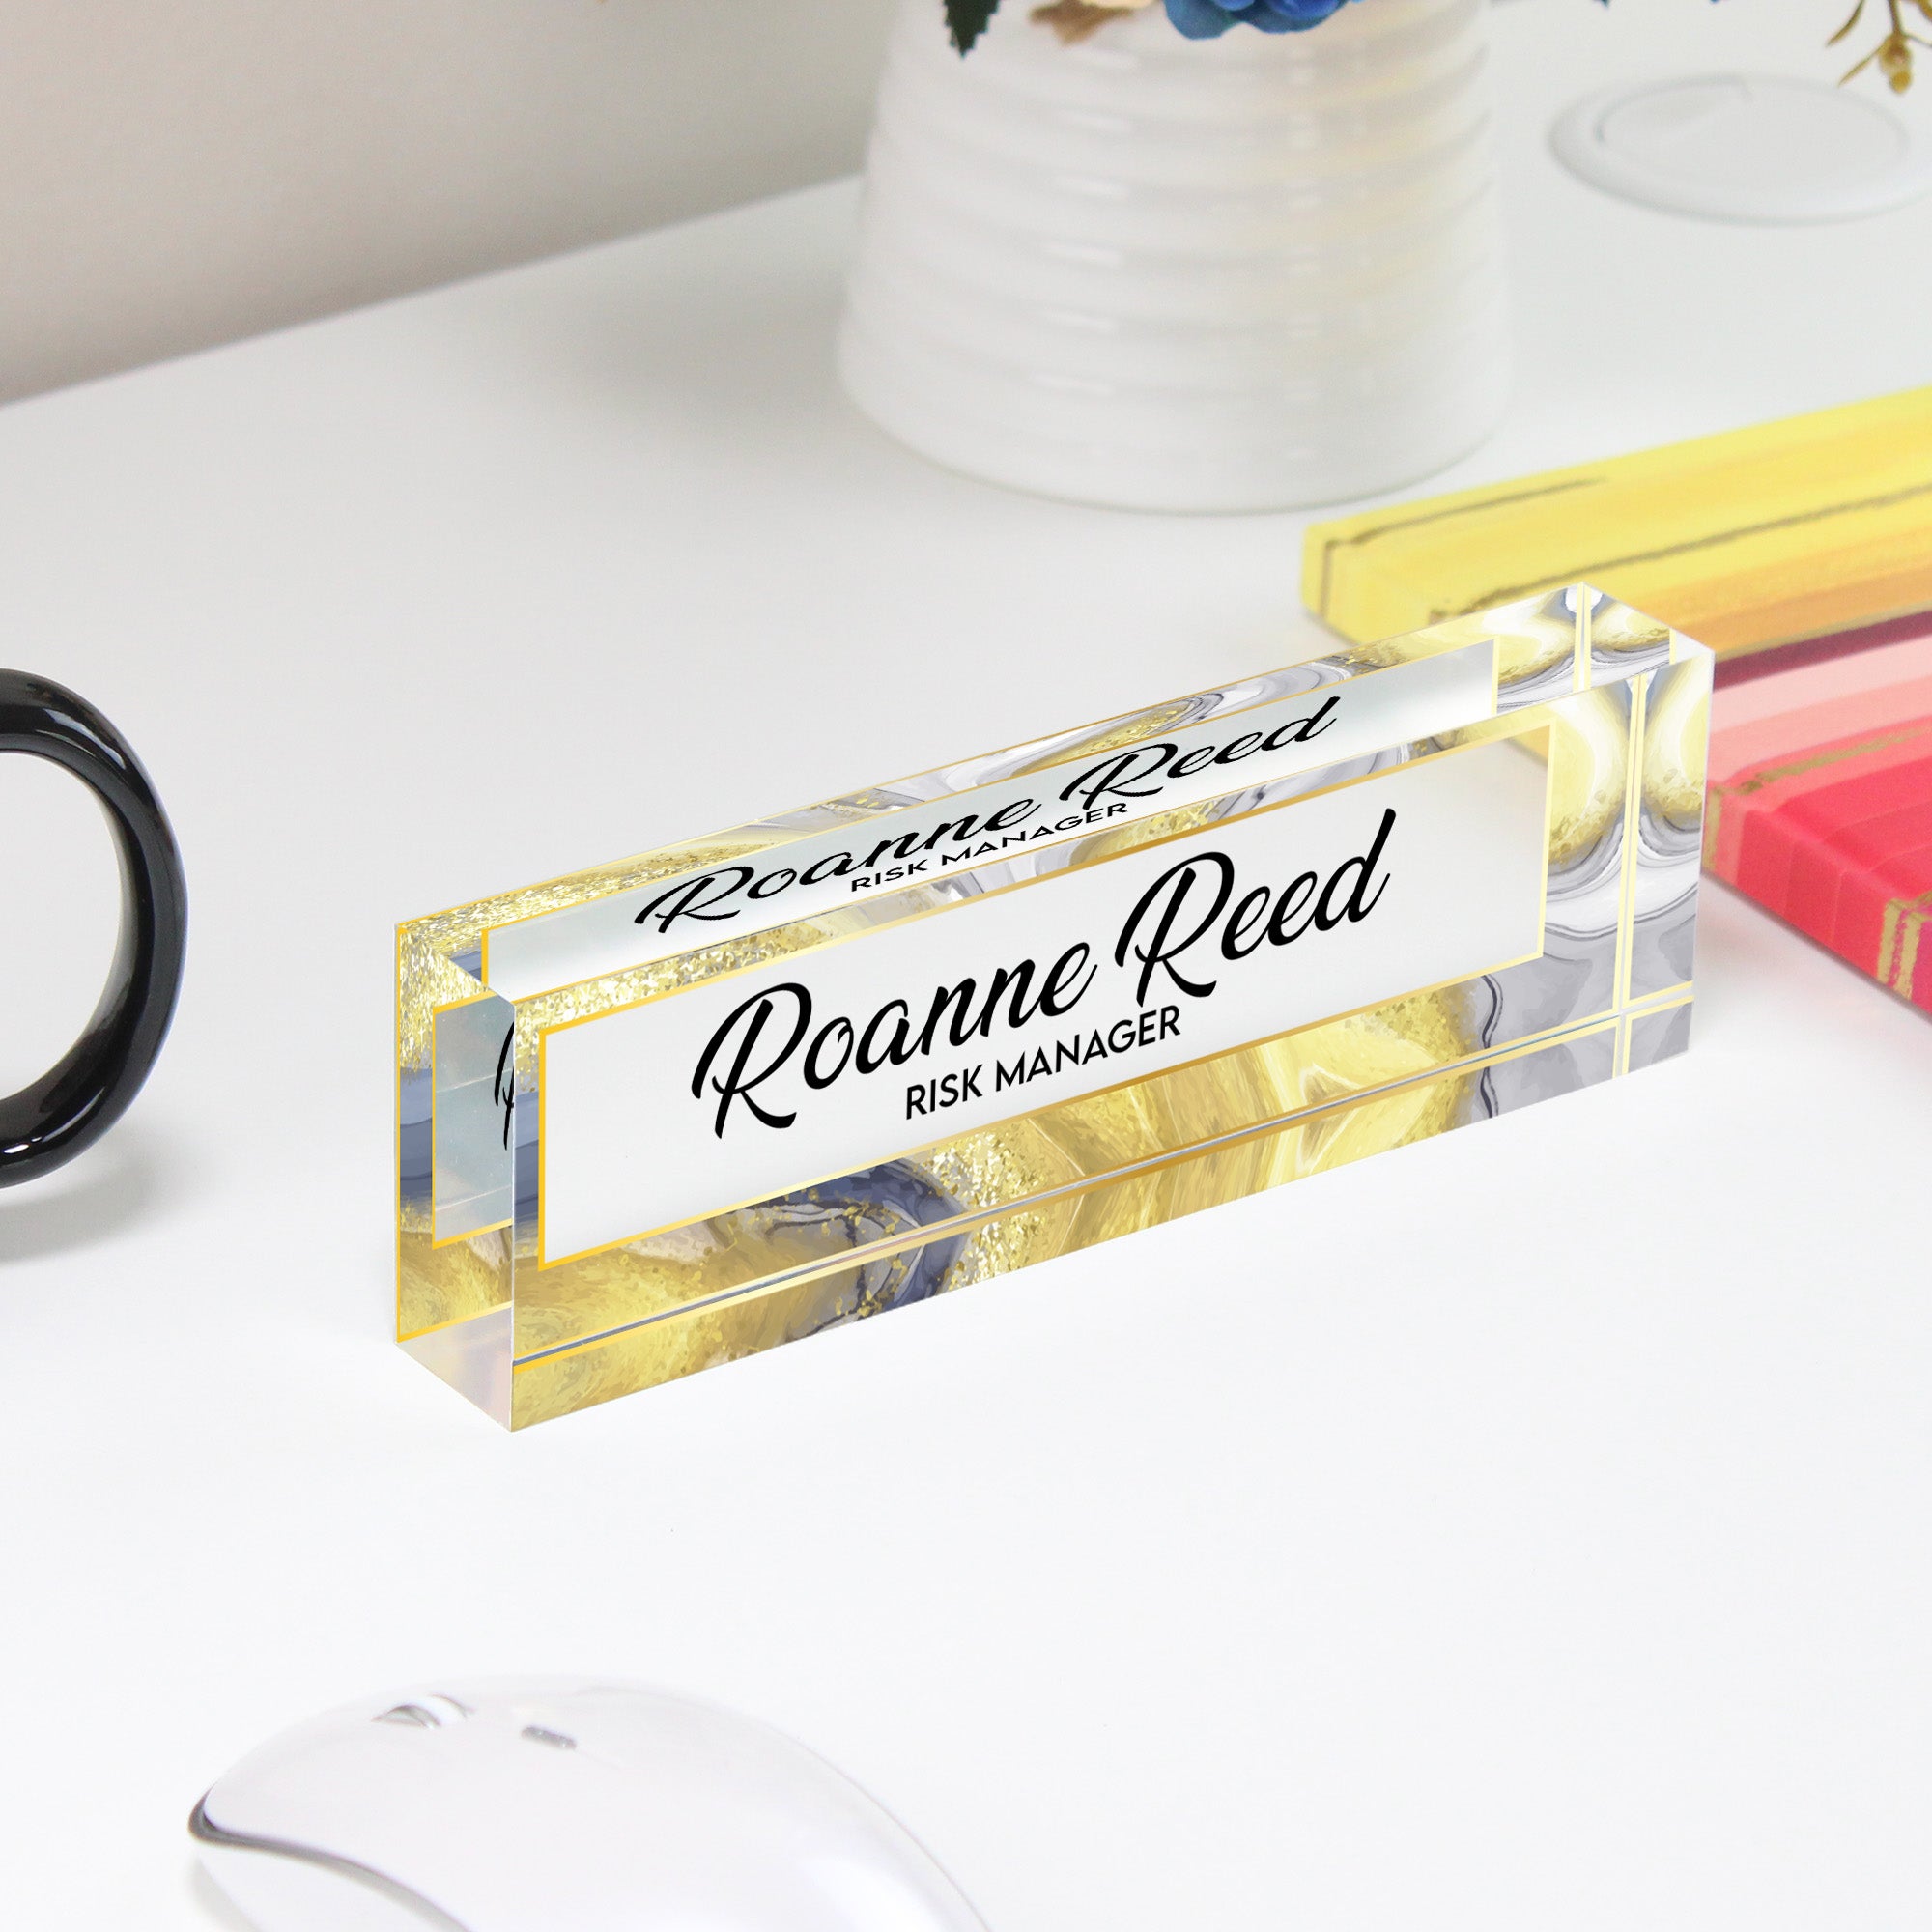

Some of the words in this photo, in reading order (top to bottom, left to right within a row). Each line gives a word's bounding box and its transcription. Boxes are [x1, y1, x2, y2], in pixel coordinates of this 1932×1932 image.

[634, 798, 1042, 934] Roanne
[1058, 696, 1341, 810] Reed
[851, 858, 928, 893] RISK
[941, 802, 1128, 866] MANAGER
[691, 942, 1098, 1139] Roanne
[1114, 808, 1397, 1008] Reed
[906, 1064, 983, 1121] RISK
[995, 1005, 1181, 1092] MANAGER
